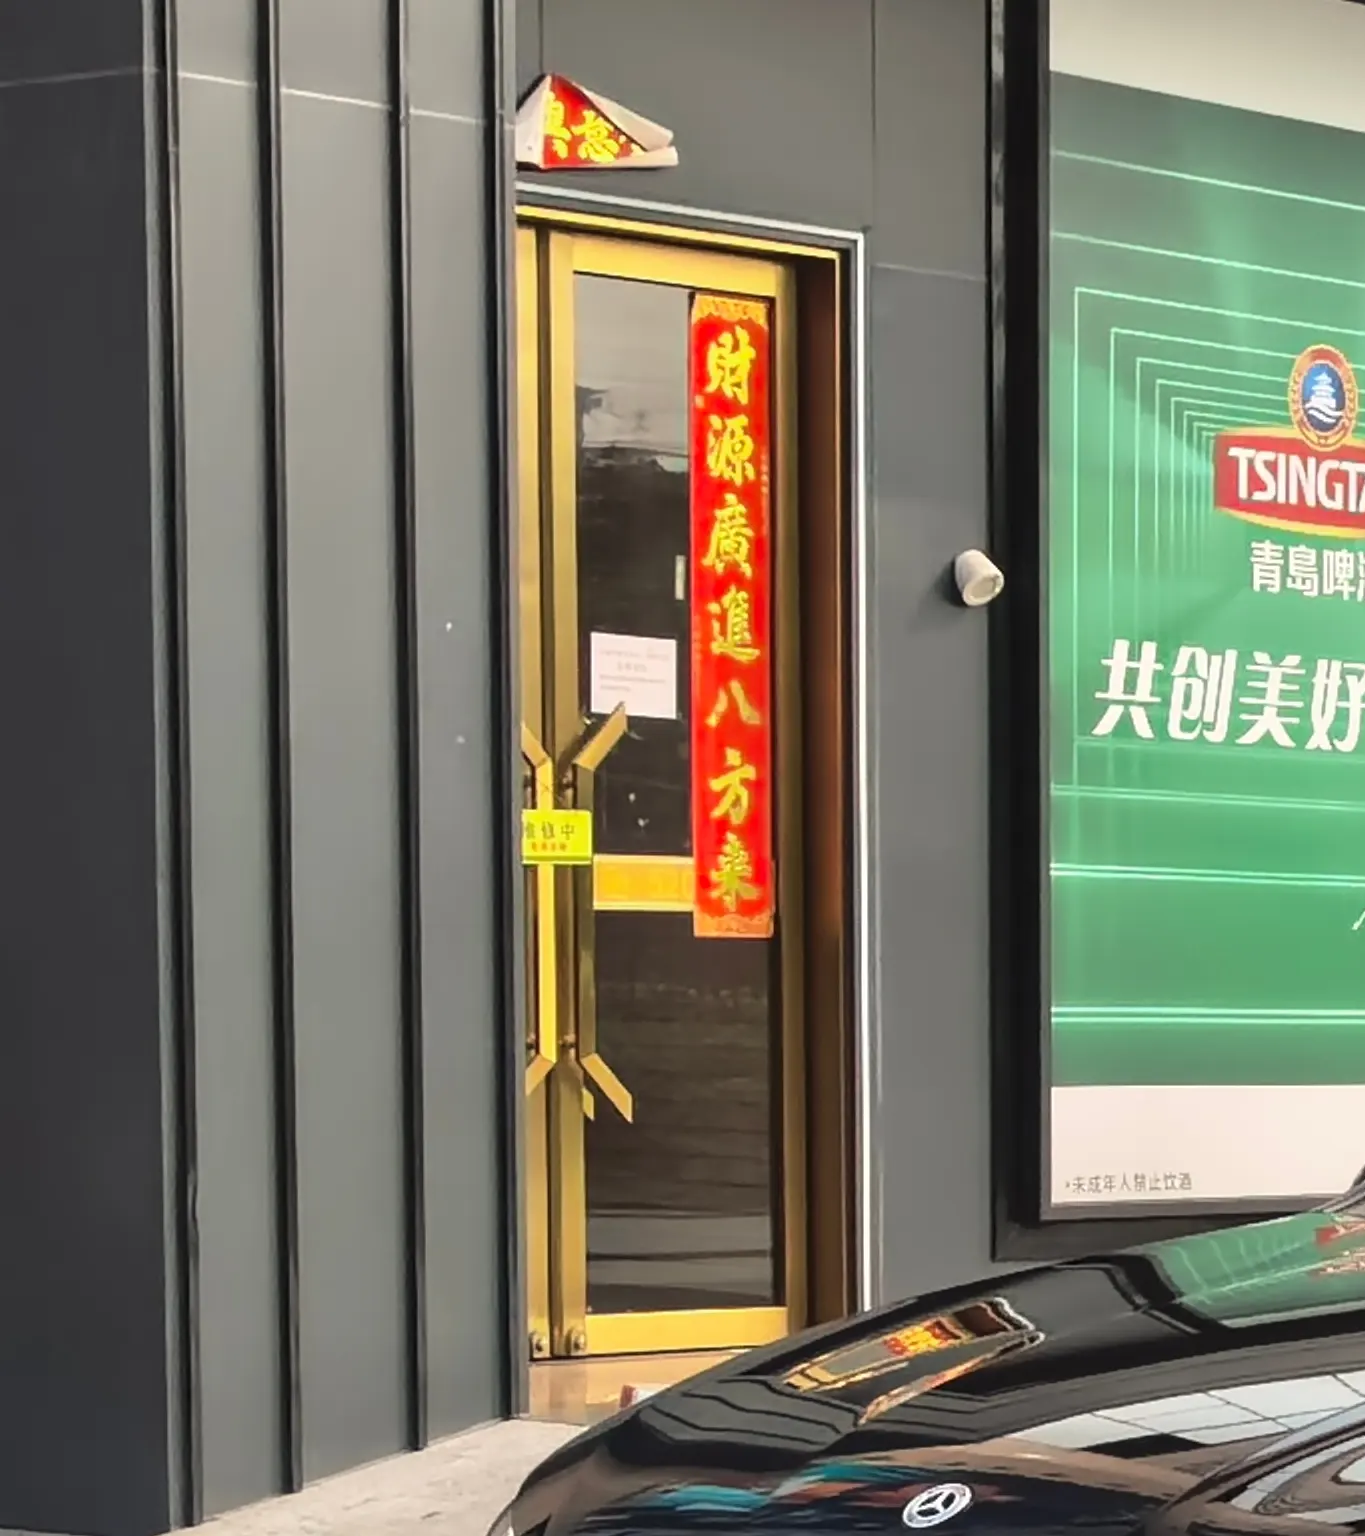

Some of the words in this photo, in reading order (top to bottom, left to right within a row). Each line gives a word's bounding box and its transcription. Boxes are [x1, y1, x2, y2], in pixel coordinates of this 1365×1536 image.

[701, 324, 762, 912] 財源廣進八方來
